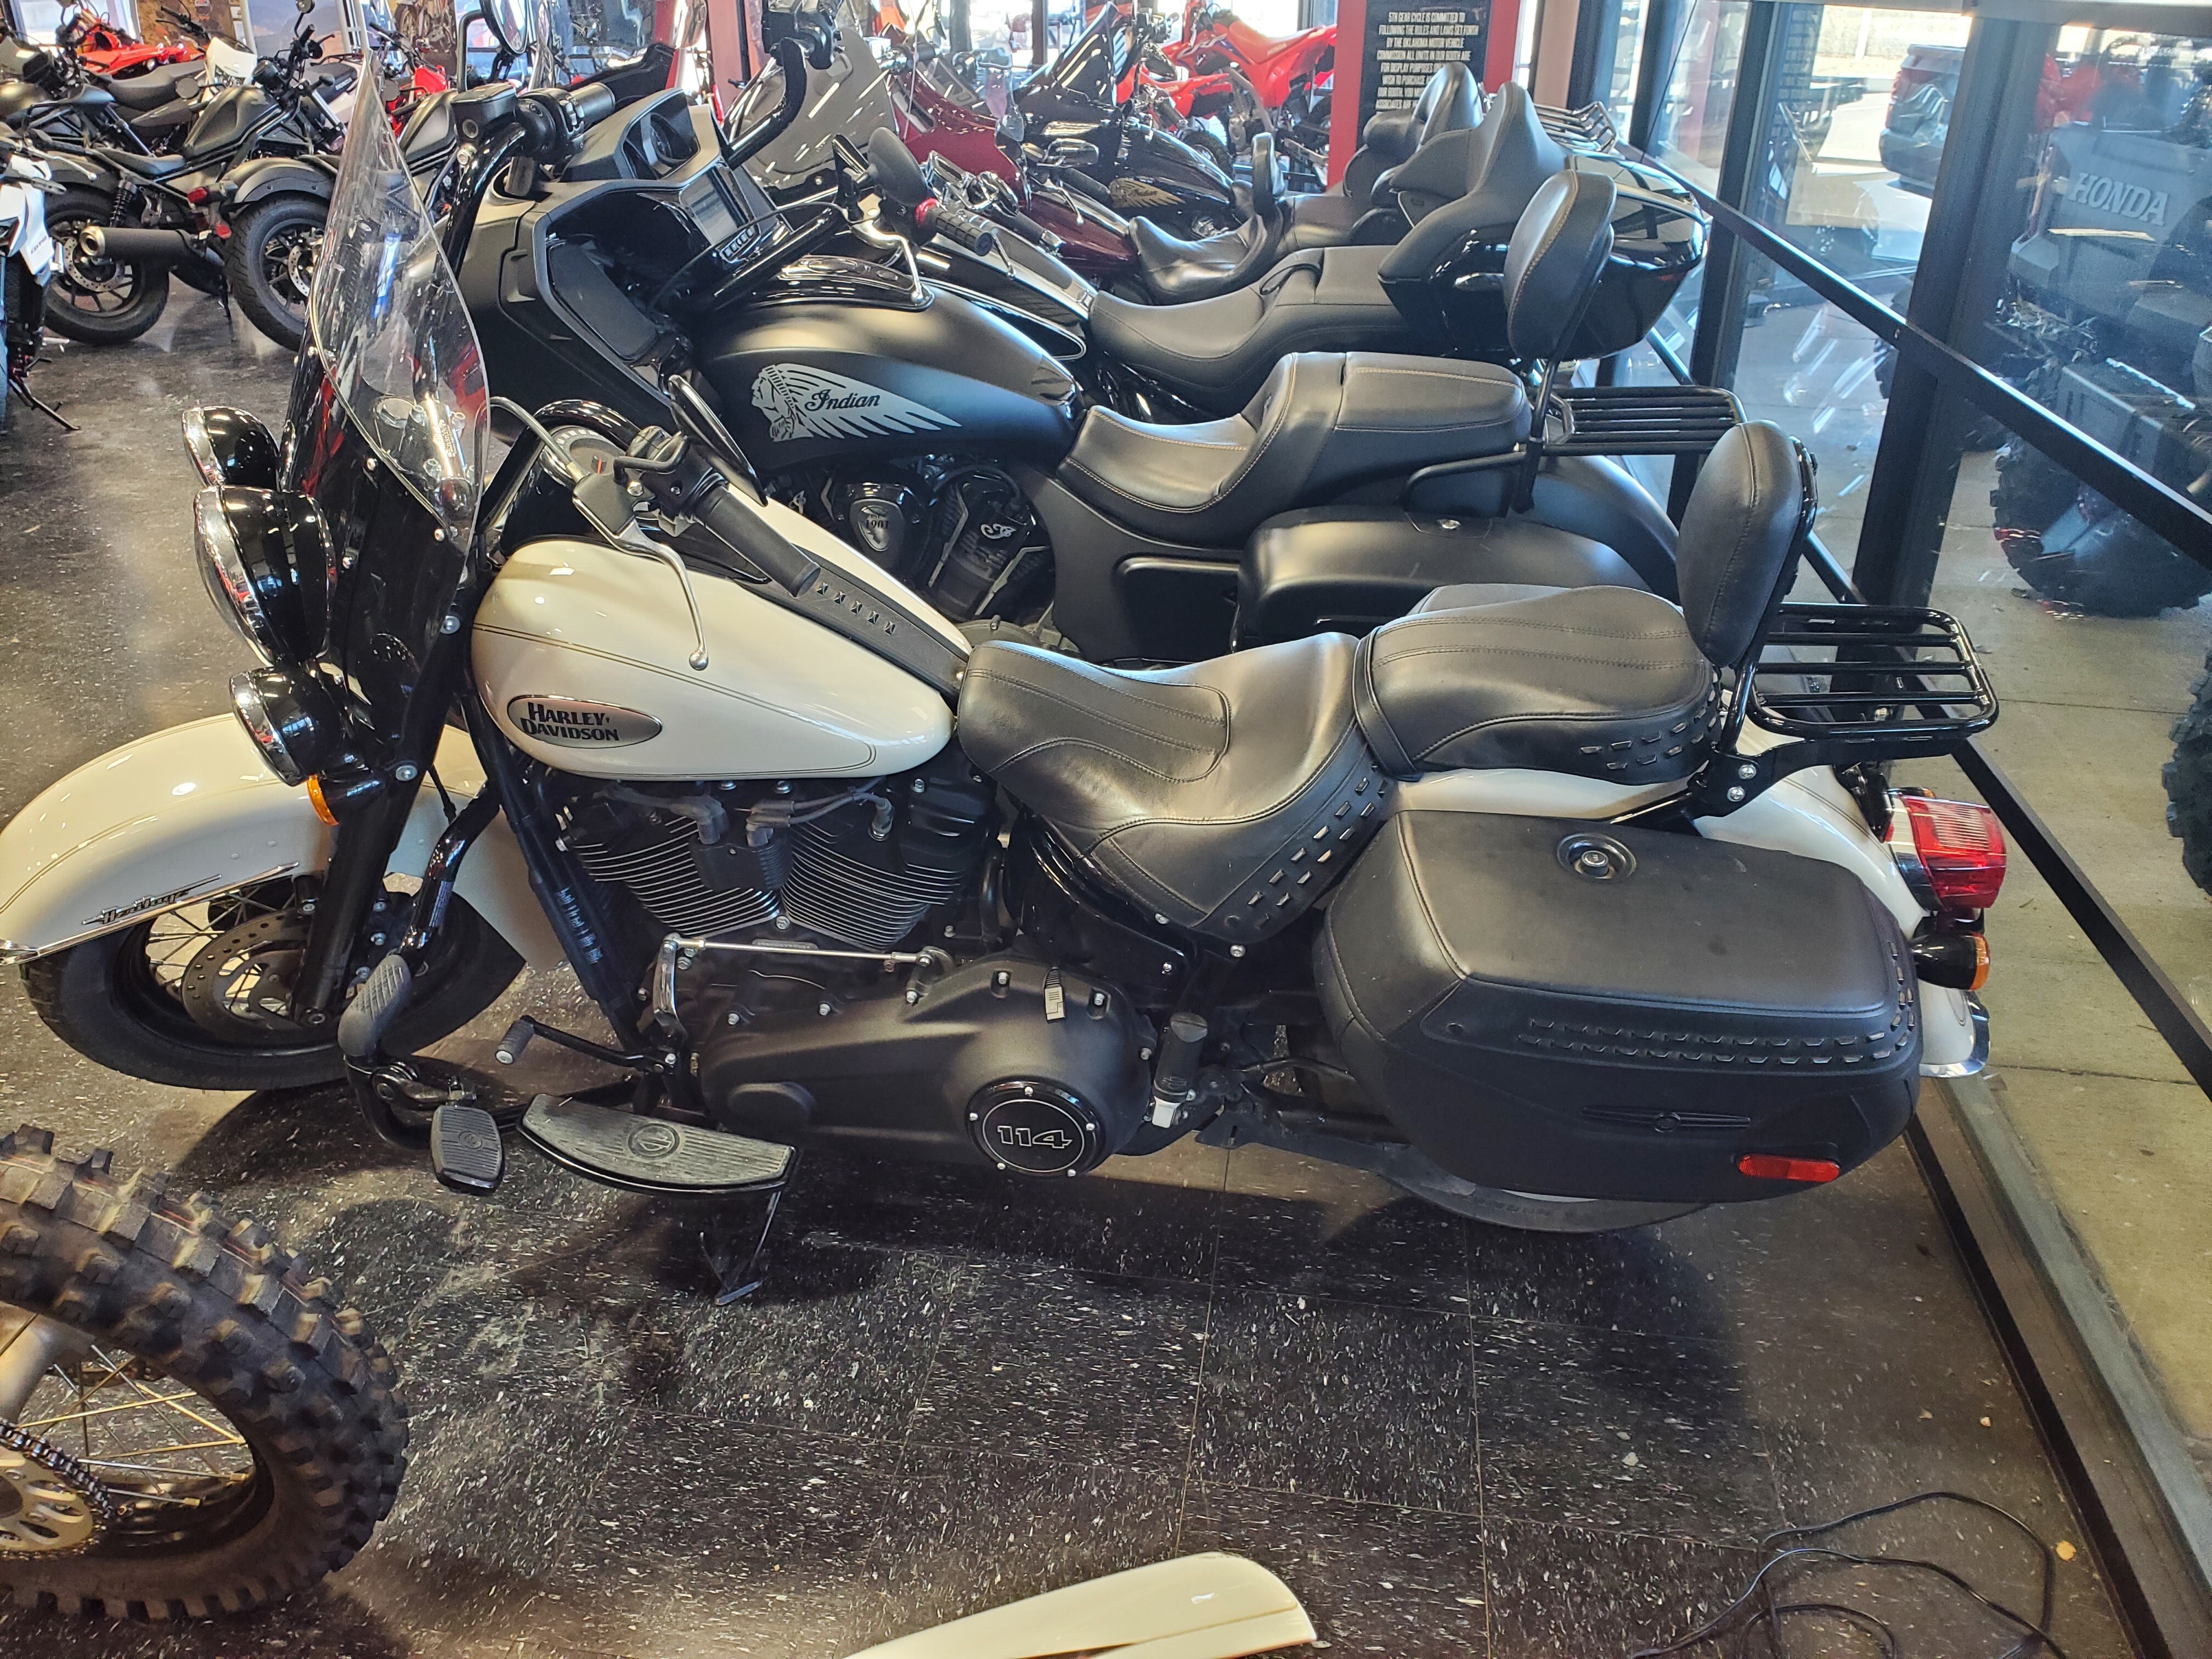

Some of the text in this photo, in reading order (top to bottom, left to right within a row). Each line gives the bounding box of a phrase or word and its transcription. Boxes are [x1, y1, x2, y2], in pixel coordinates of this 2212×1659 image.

[1398, 12, 1410, 22] GEAR
[1411, 12, 1425, 22] CYCLE
[1426, 12, 1431, 22] IS
[1431, 12, 1458, 22] COMMITTED
[1379, 25, 1405, 35] FOLLOWING
[1406, 25, 1414, 35] THE
[1430, 25, 1440, 35] AND
[1440, 25, 1454, 35] LAWS
[1454, 25, 1463, 35] SET
[1394, 37, 1403, 48] THE
[1403, 37, 1428, 48] OKLAHOMA
[1445, 37, 1465, 48] VEHICLE
[1406, 50, 1415, 60] ALL
[1390, 62, 1409, 73] DISPLAY
[1409, 62, 1434, 73] PURPOSES
[2068, 172, 2170, 226] HONDA
[804, 389, 881, 411] Indian
[866, 520, 889, 529] 1901
[520, 717, 620, 741] DAVIDSON
[997, 1125, 1073, 1149] 114
